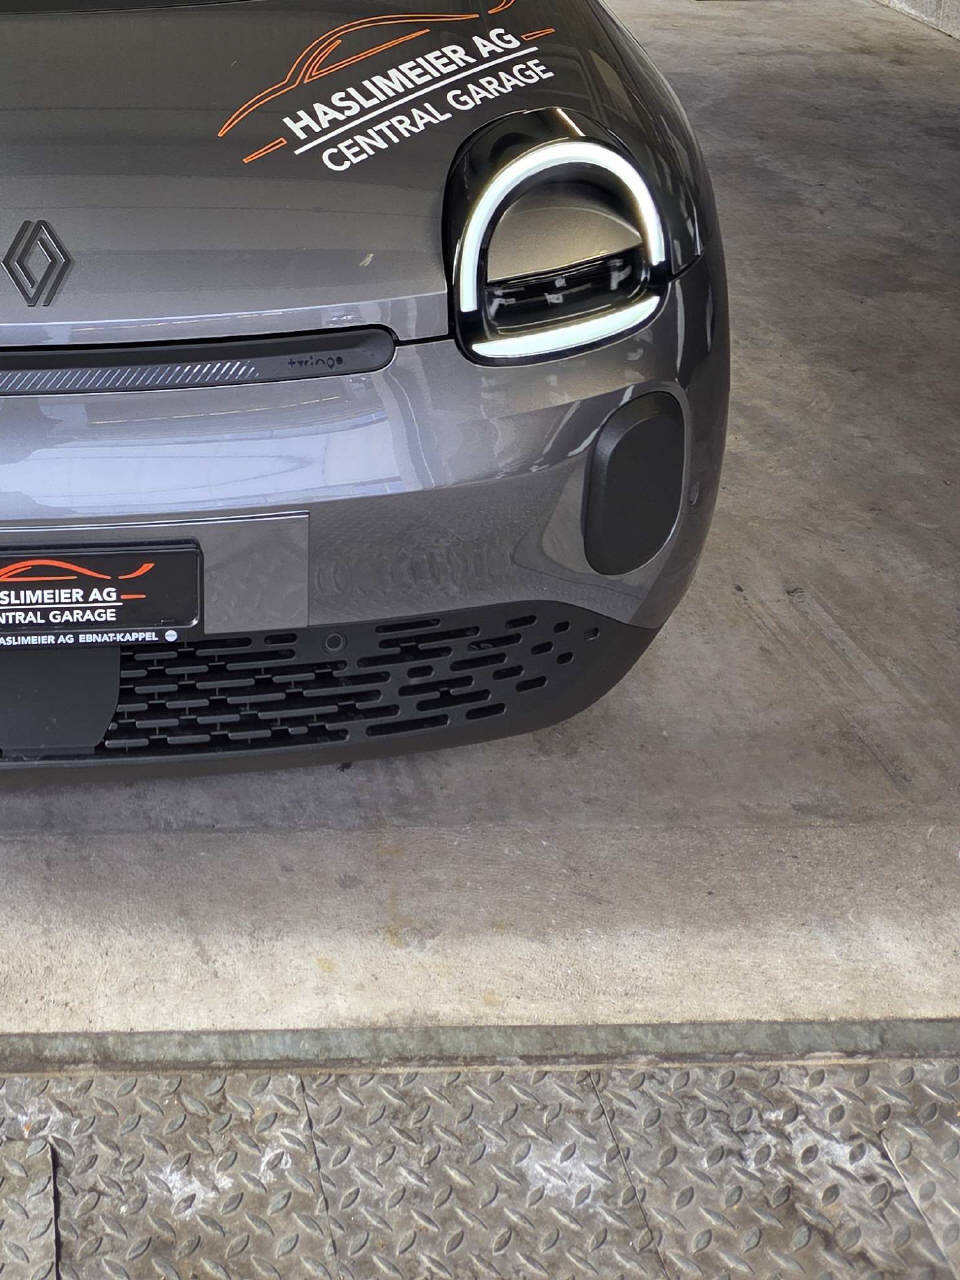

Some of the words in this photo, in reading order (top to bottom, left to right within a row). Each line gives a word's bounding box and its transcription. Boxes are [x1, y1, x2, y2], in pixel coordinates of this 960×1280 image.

[281, 44, 478, 140] HASLIMEIER
[471, 28, 521, 58] AG
[321, 102, 453, 172] CENTRAL
[446, 58, 555, 111] GARAGE
[87, 587, 117, 602] AG
[48, 608, 117, 624] GARAGE
[57, 633, 75, 644] AG
[78, 631, 159, 643] EBNAT-KAPPEL
